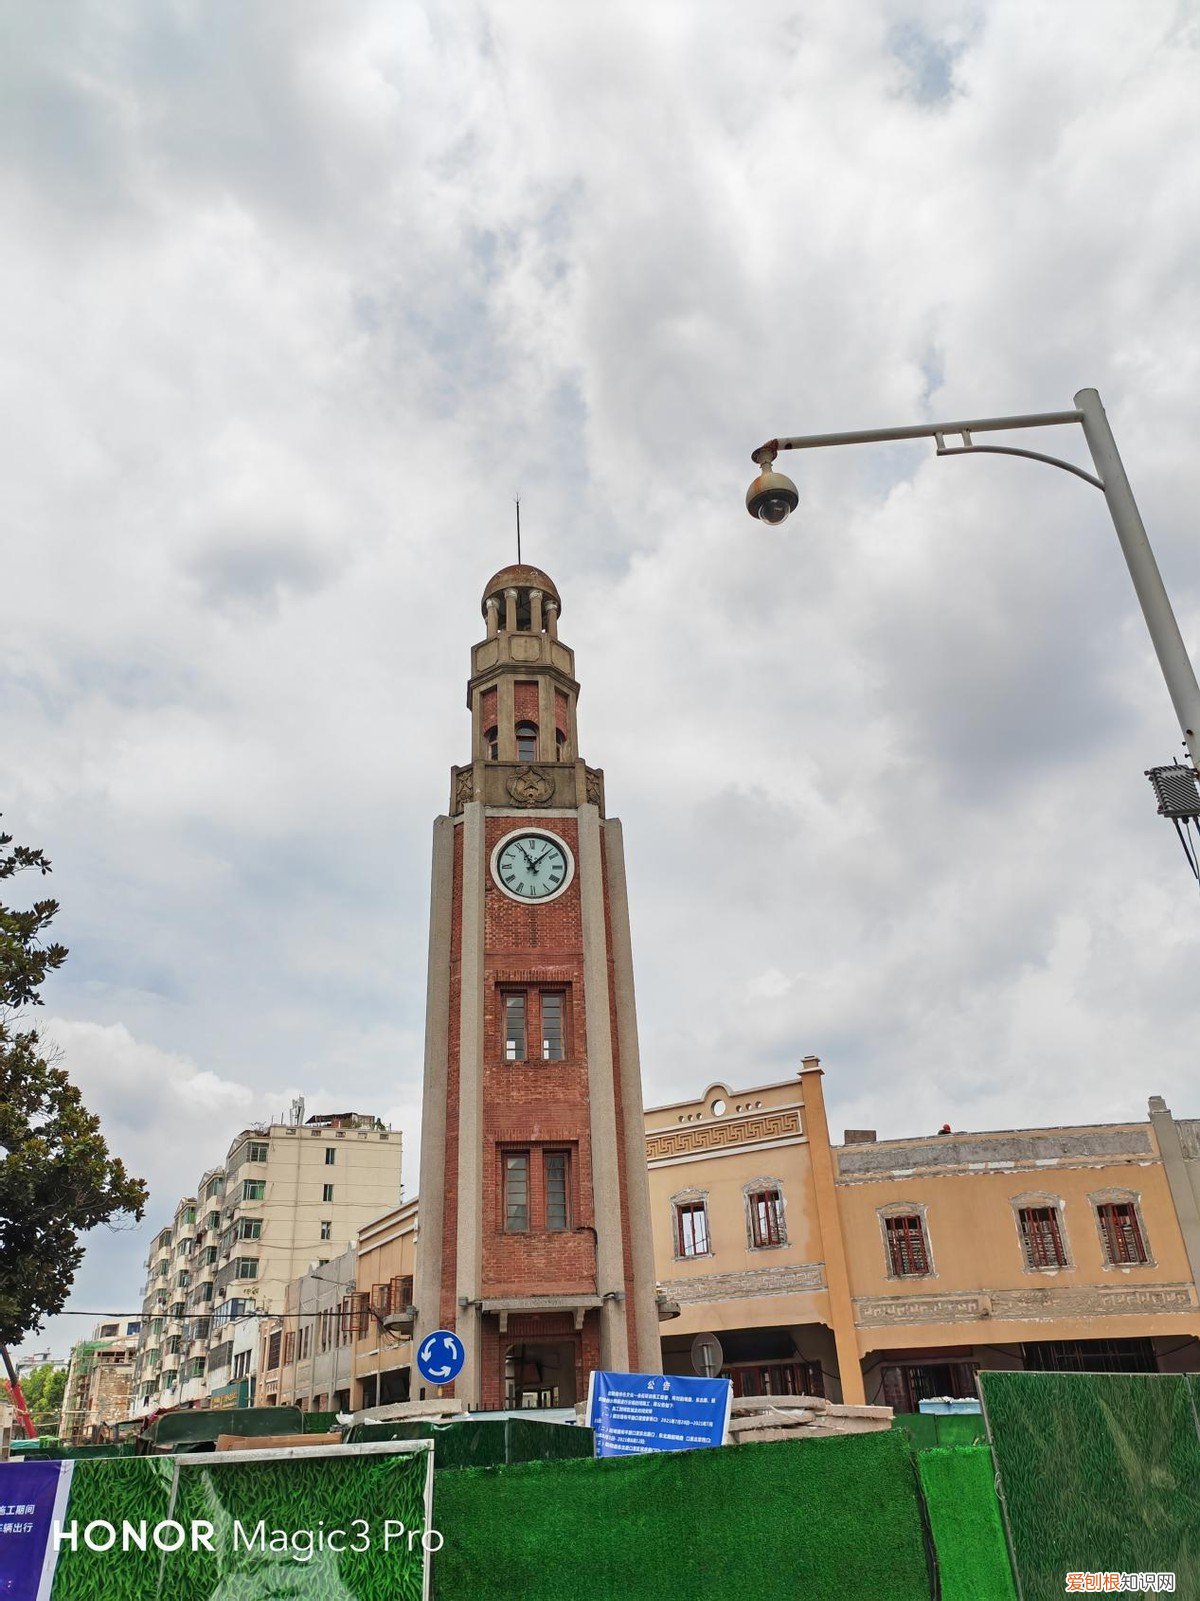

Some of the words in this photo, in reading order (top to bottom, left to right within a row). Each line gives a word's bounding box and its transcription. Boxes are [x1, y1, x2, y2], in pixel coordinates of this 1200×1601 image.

[647, 1380, 671, 1391] 公告
[0, 1522, 34, 1533] 辆出行
